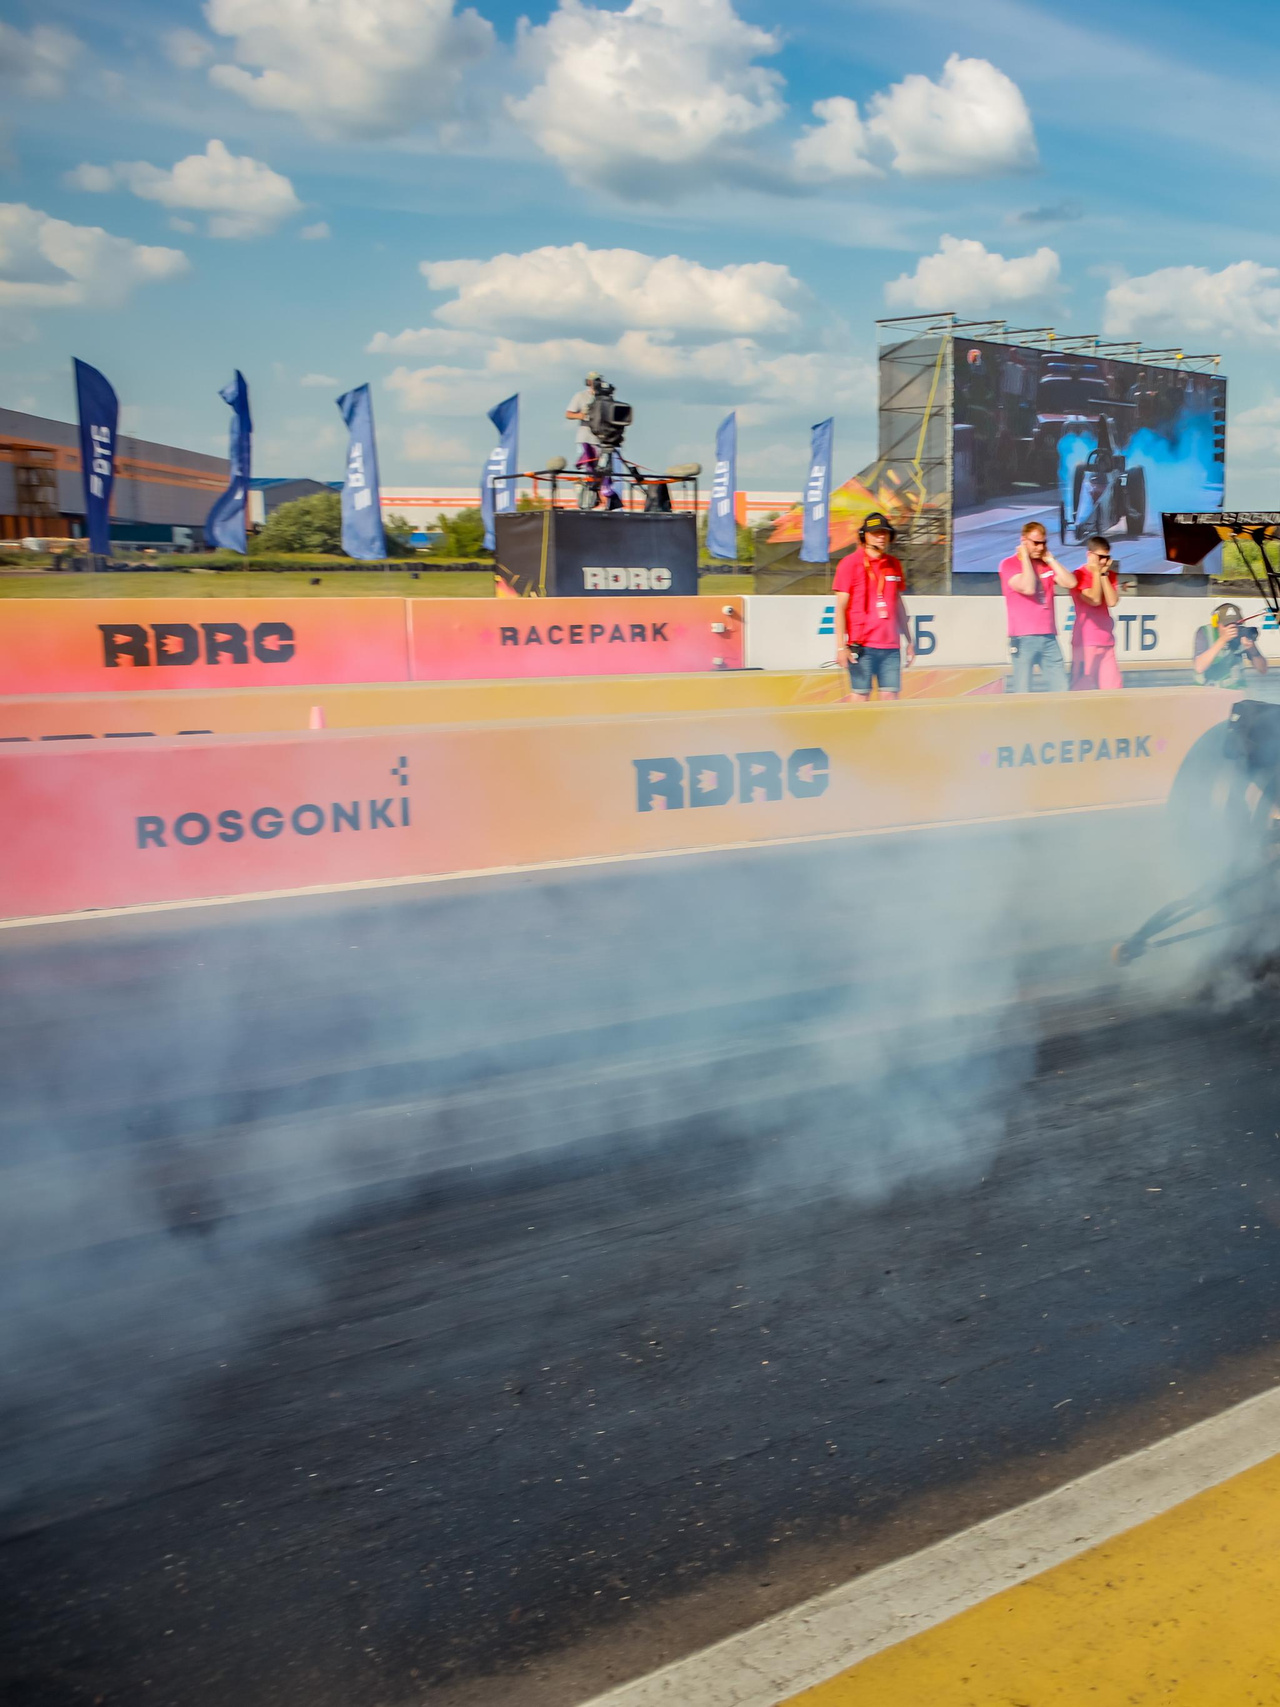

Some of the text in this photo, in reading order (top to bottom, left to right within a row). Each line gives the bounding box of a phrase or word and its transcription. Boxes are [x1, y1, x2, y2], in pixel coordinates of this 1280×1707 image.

[582, 567, 672, 590] RDRC
[98, 622, 296, 668] RDRC
[499, 622, 669, 646] RACEPARK
[996, 735, 1152, 768] RACEPARK
[632, 747, 830, 813] RDRC
[135, 797, 410, 850] ROSGONKI
